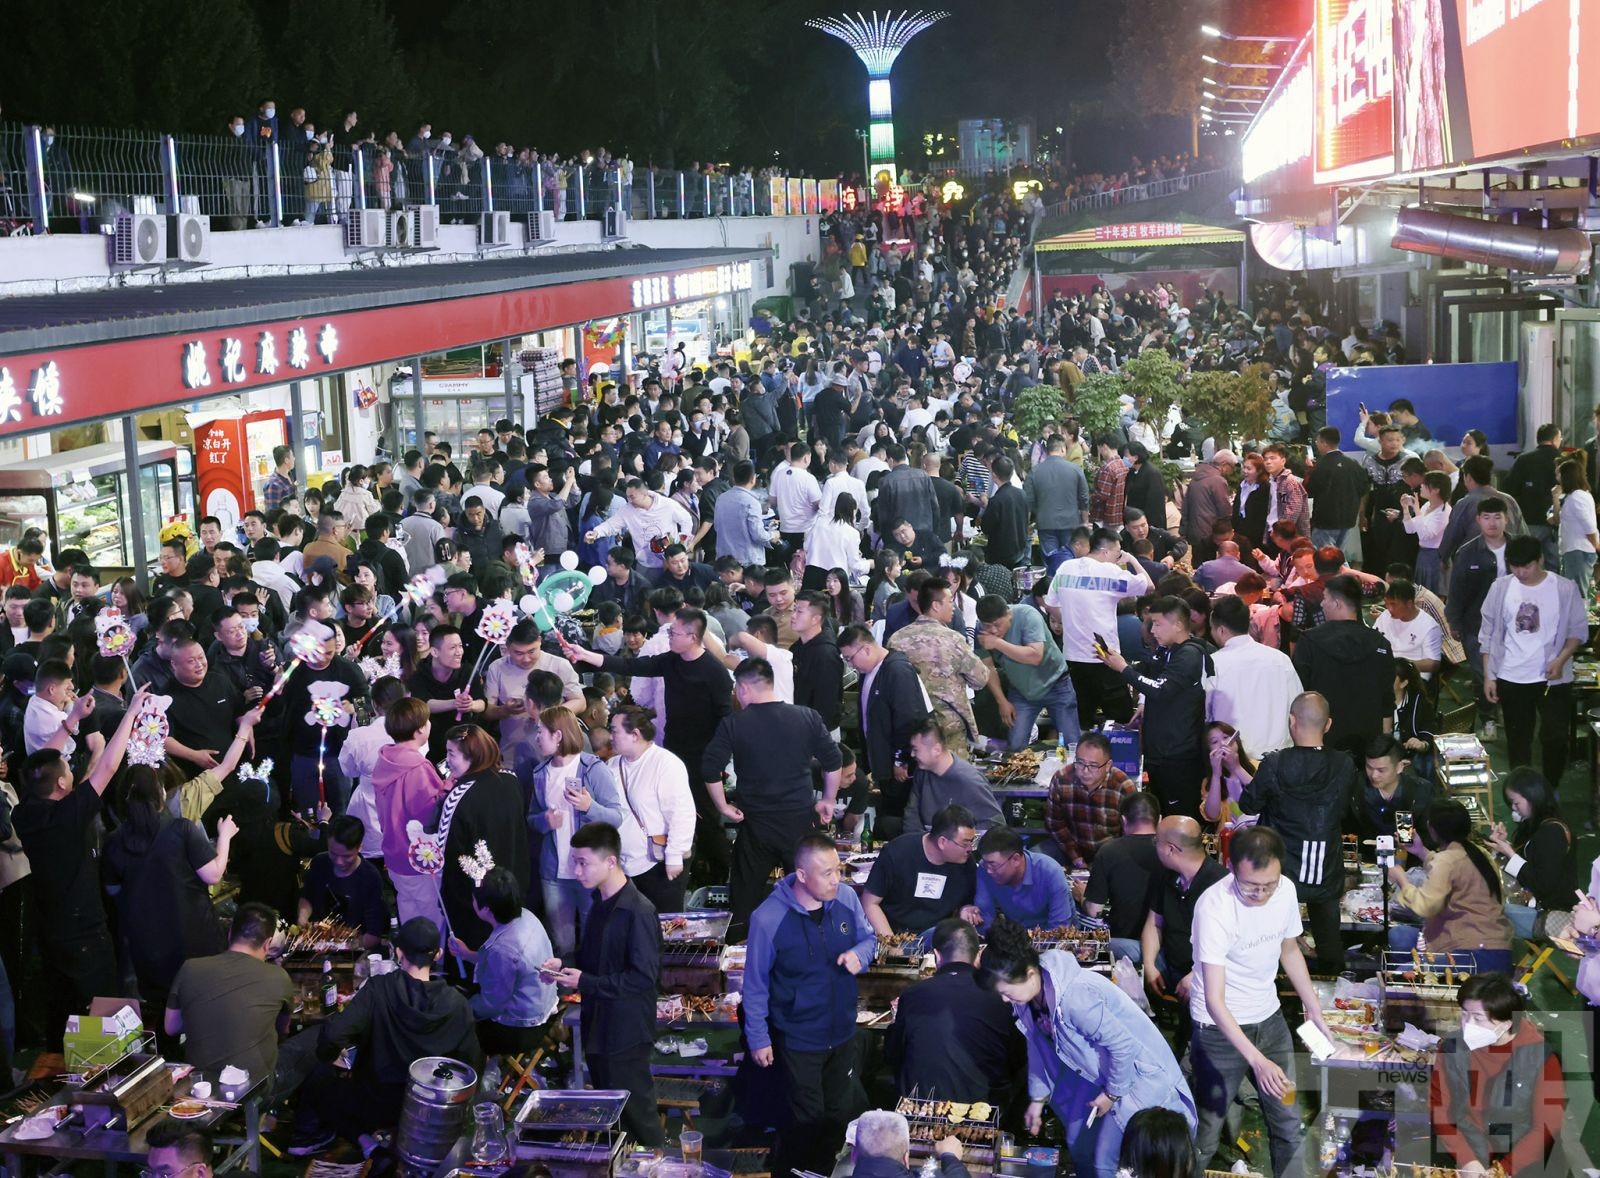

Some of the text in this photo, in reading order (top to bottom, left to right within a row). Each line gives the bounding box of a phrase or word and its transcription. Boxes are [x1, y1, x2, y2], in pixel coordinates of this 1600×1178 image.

[1095, 225, 1137, 239] 三十年老店
[202, 438, 231, 451] 凉白开
[209, 452, 227, 464] 红了
